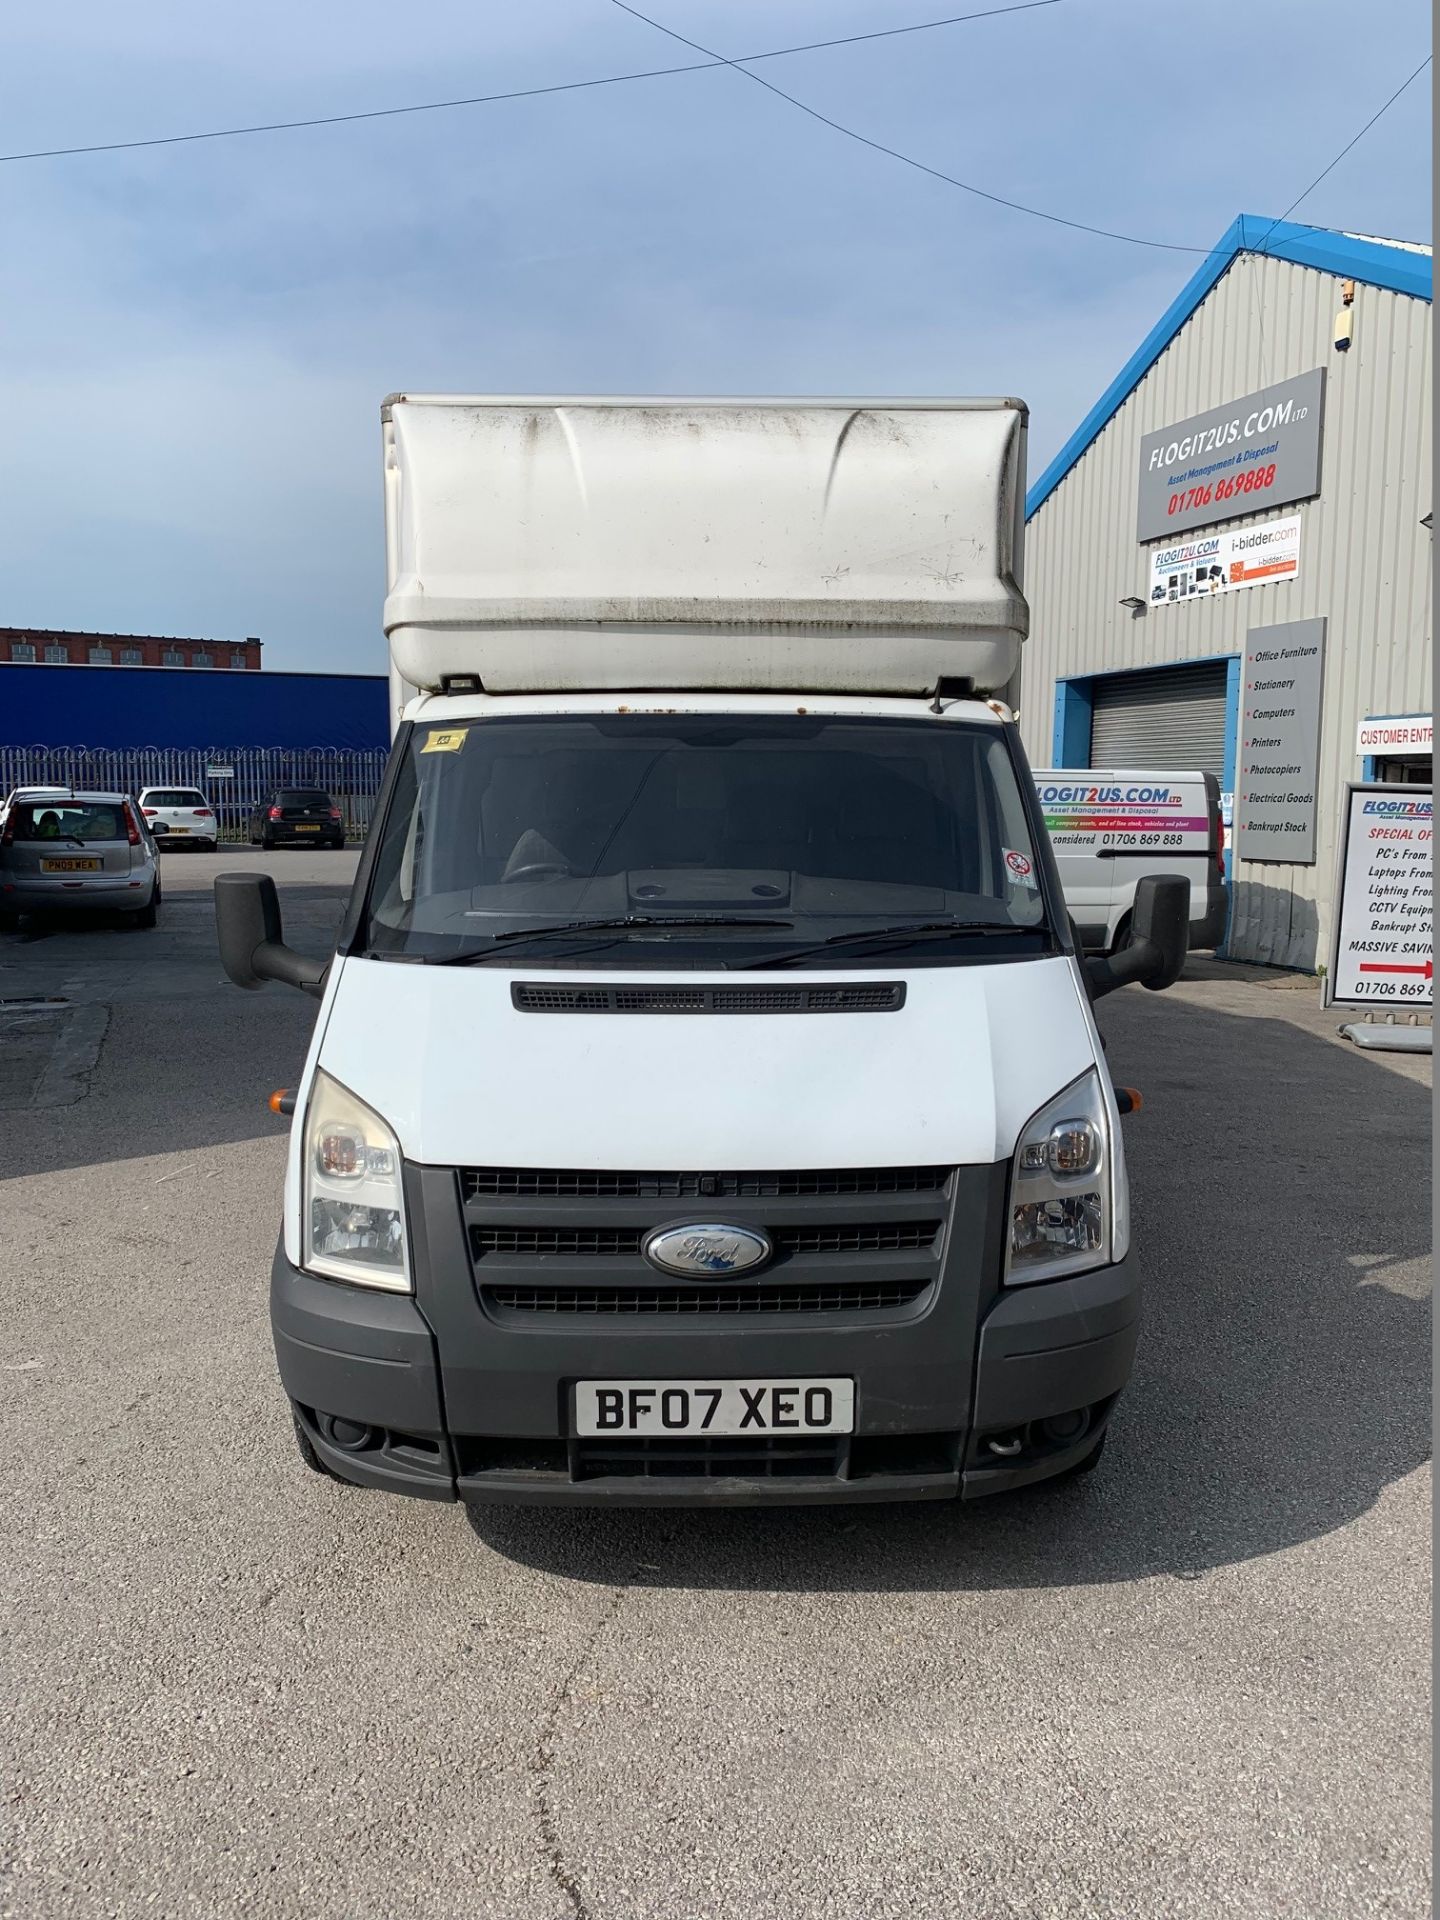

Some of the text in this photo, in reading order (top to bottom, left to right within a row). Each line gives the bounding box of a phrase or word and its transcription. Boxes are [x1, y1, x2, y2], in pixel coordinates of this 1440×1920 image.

[1149, 400, 1308, 471] FLOGIT2US.COM LTD
[1168, 441, 1279, 486] Asset Management & Disposal
[1168, 463, 1277, 515] 01706 869888
[1231, 527, 1297, 552] i-bidder.com
[1156, 538, 1219, 565] FLOGIT2U.COM
[1158, 562, 1190, 576] Auctioneers
[1196, 556, 1217, 566] Valuers
[1255, 647, 1318, 662] Office Furniture
[1254, 680, 1295, 691] Stationery
[1253, 708, 1295, 720] Computers
[1251, 737, 1281, 748] Printers
[1361, 728, 1409, 745] CUSTOMER
[1250, 764, 1301, 776] Photocopiers
[1249, 792, 1313, 803] Electrical Goods
[1071, 806, 1120, 815] Management
[1128, 807, 1159, 815] Disposal
[1248, 821, 1307, 833] Bankrupt Stock
[1368, 828, 1413, 840] SPECIAL
[1053, 833, 1183, 845] considered 01706 869 888
[1376, 847, 1399, 859] PC's
[1402, 849, 1427, 860] From
[1368, 865, 1406, 880] Laptops
[1368, 883, 1409, 898] Lighting
[1369, 902, 1399, 913] CCTV
[1370, 920, 1416, 934] Bankrupt
[1348, 940, 1399, 953] MASSIVE
[1355, 982, 1396, 995] 01706
[1400, 984, 1425, 996] 869
[676, 1236, 741, 1263] Ford
[596, 1386, 833, 1430] BF07 XEO
